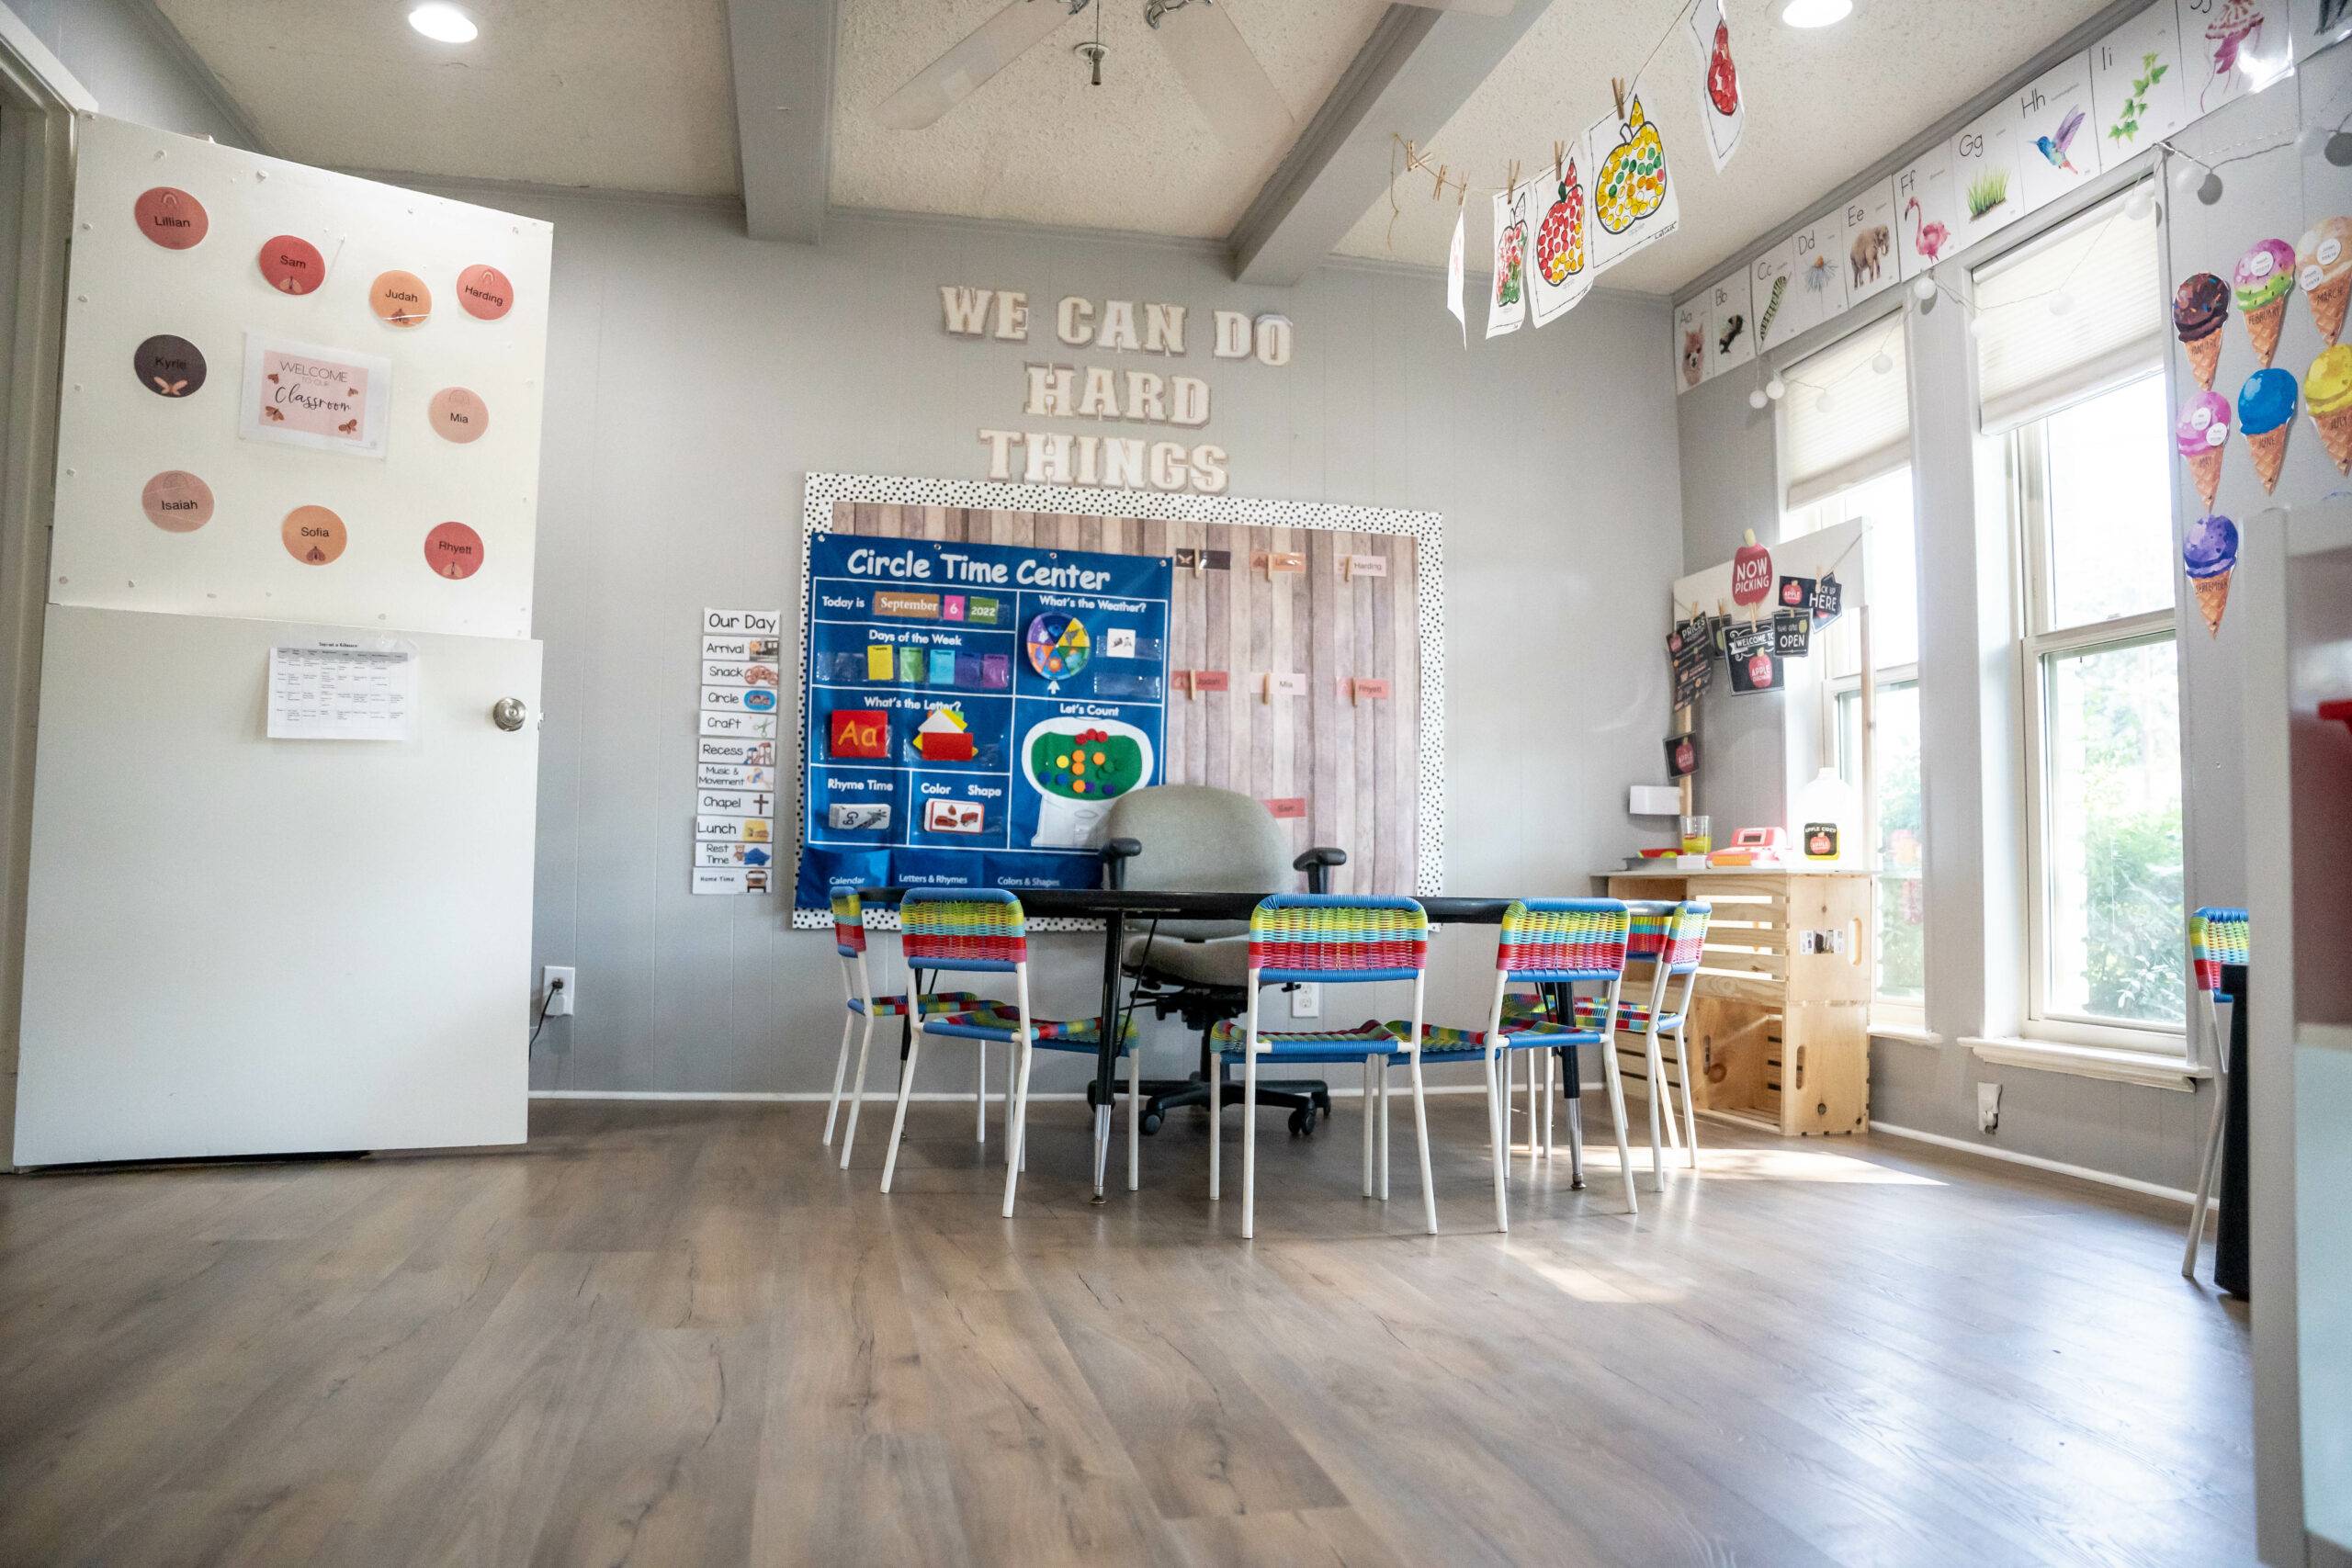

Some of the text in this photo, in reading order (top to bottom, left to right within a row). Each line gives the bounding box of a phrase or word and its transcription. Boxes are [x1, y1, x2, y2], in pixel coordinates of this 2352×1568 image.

[2021, 88, 2045, 118] Hh
[1959, 133, 1983, 157] Gg
[1900, 169, 1916, 197] Ff
[154, 216, 191, 228] Lillian
[1848, 206, 1864, 227] Ee
[1798, 231, 1815, 255] Dd
[280, 254, 307, 269] Sam
[1758, 262, 1772, 280] Cc
[385, 289, 418, 303] Judah
[465, 285, 503, 307] Harding
[1715, 289, 1727, 307] Bb
[940, 286, 1294, 367] WE CAN DO
[279, 361, 347, 383] WELCOME
[275, 383, 353, 412] Classroom
[1023, 363, 1212, 429] HARD
[450, 412, 469, 423] Mia
[978, 428, 1229, 495] THINGS
[161, 500, 198, 511] Isaiah
[301, 526, 330, 537] Sofia
[438, 541, 472, 555] Rhyett
[847, 548, 1111, 591] Circle Time Center
[1737, 557, 1768, 581] NOW
[1735, 575, 1770, 593] PICKING
[821, 595, 996, 616] Today is September 6 2022
[1039, 594, 1147, 613] What's the Weather?
[1809, 593, 1837, 611] HERE
[709, 613, 776, 633] Our Day
[1681, 618, 1705, 638] PRICES
[868, 629, 963, 646] Days of the Week
[1736, 634, 1766, 648] WELCOME
[1780, 634, 1805, 648] OPEN
[707, 643, 744, 654] Arrival
[709, 666, 743, 677] Snack
[1751, 664, 1770, 677] APPLE
[708, 692, 740, 704] Circle
[864, 696, 961, 712] What's the Letter?
[1060, 703, 1119, 716] Let's Count
[707, 717, 741, 729] Craft
[838, 720, 877, 748] Aa
[703, 744, 743, 755] Recess
[706, 766, 730, 775] Music
[698, 776, 745, 785] Movement
[828, 779, 893, 792] Rhyme Time
[921, 783, 952, 795] Color
[967, 785, 1001, 797] Shape
[703, 796, 741, 810] Chapel
[842, 811, 859, 826] Gg
[697, 821, 737, 834] Lunch
[707, 844, 729, 852] Rest
[707, 855, 729, 864] Time
[830, 876, 865, 885] Calendar
[899, 874, 926, 883] Letters
[936, 875, 967, 885] Rhymes
[997, 876, 1023, 886] Colors
[1032, 878, 1060, 886] Shapes
